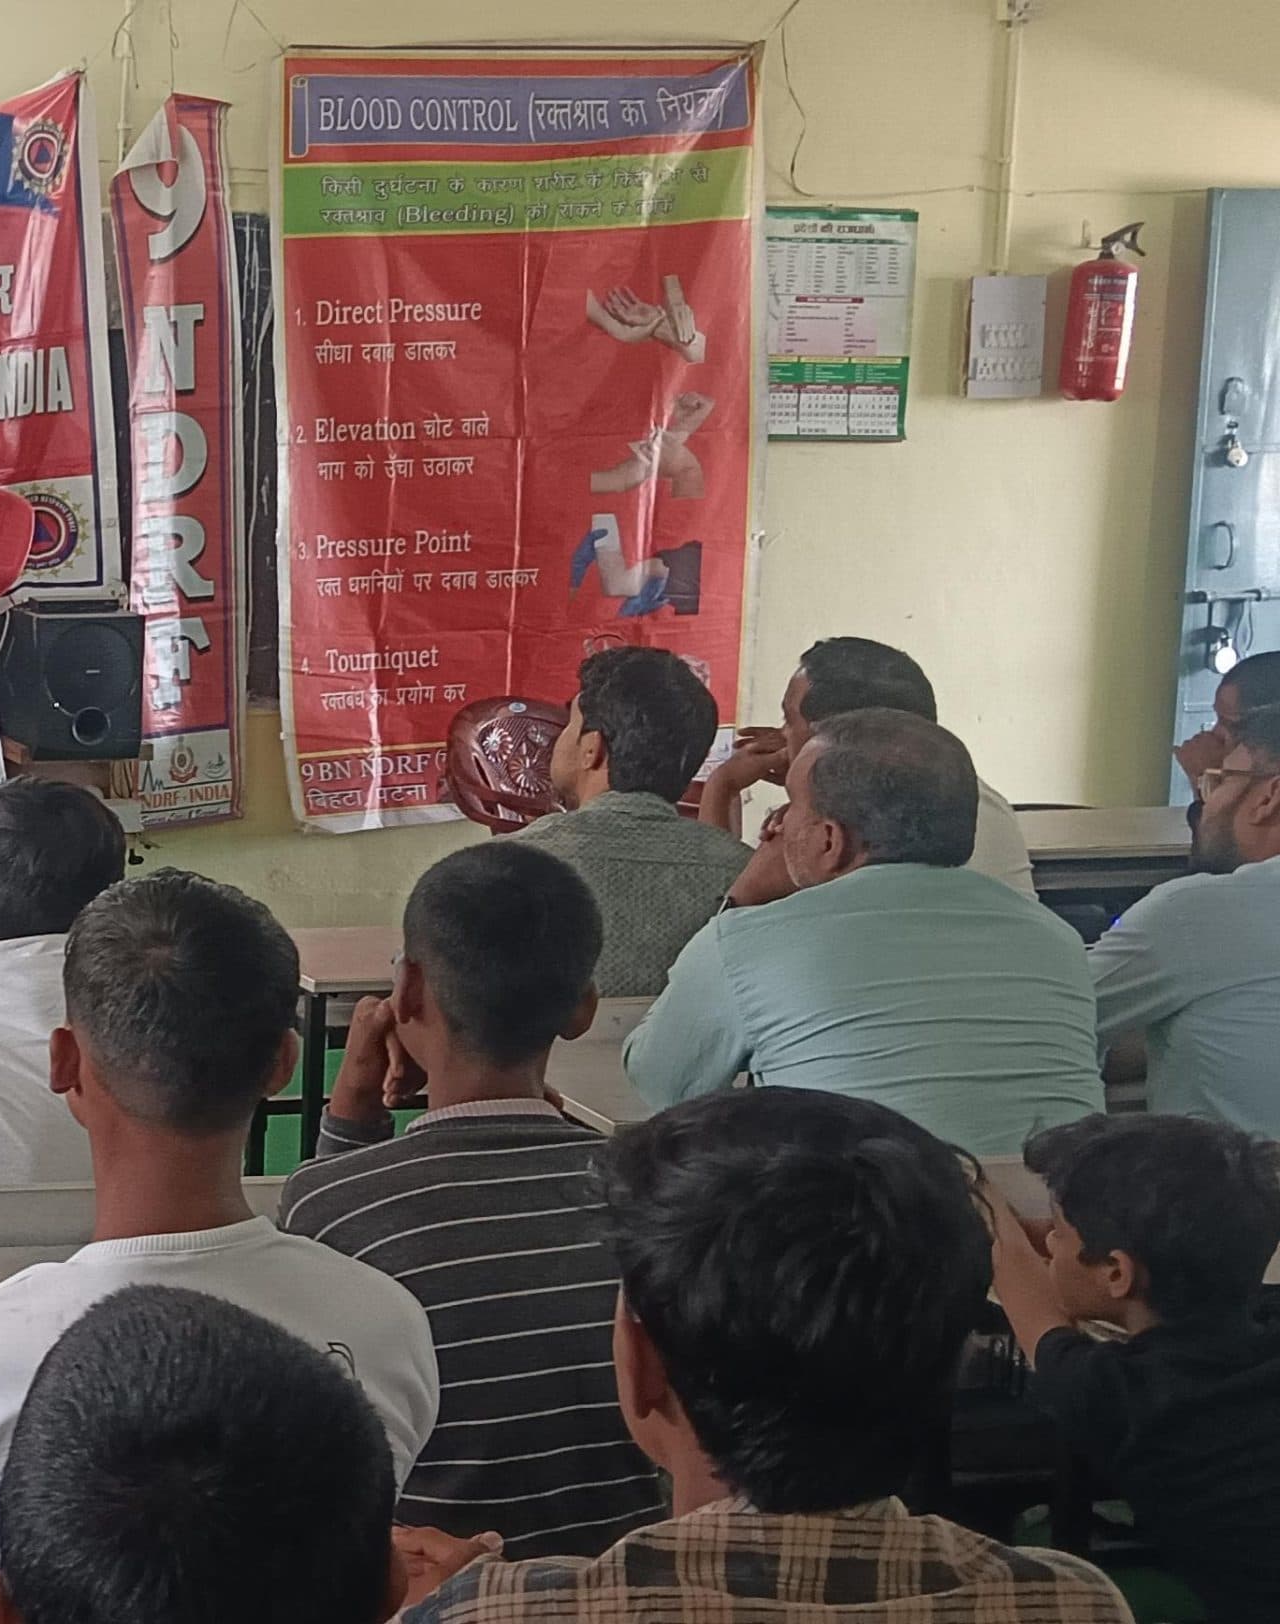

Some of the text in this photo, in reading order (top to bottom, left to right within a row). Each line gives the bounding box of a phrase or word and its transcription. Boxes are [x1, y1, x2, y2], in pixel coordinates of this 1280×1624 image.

[319, 98, 402, 133] BLOOD
[410, 97, 519, 132] CONTROL
[619, 99, 648, 128] का
[397, 204, 515, 228] (Bleeding)
[315, 298, 384, 327] Direct
[388, 297, 483, 324] Pressure
[315, 340, 457, 366] सीधा डालकर
[315, 411, 491, 442] Elevation चोट वाले
[354, 456, 375, 479] को
[423, 456, 475, 477] उठाकर
[316, 533, 407, 560] Pressure
[414, 528, 473, 555] Point
[413, 574, 434, 593] पर
[485, 566, 541, 590] डालकर
[325, 644, 440, 675] Tourniquet
[396, 679, 437, 706] प्रयोग
[443, 683, 468, 703] कर
[301, 762, 315, 783] 9
[319, 757, 353, 782] BN
[359, 751, 433, 779] NDRF
[189, 783, 230, 803] INDIA
